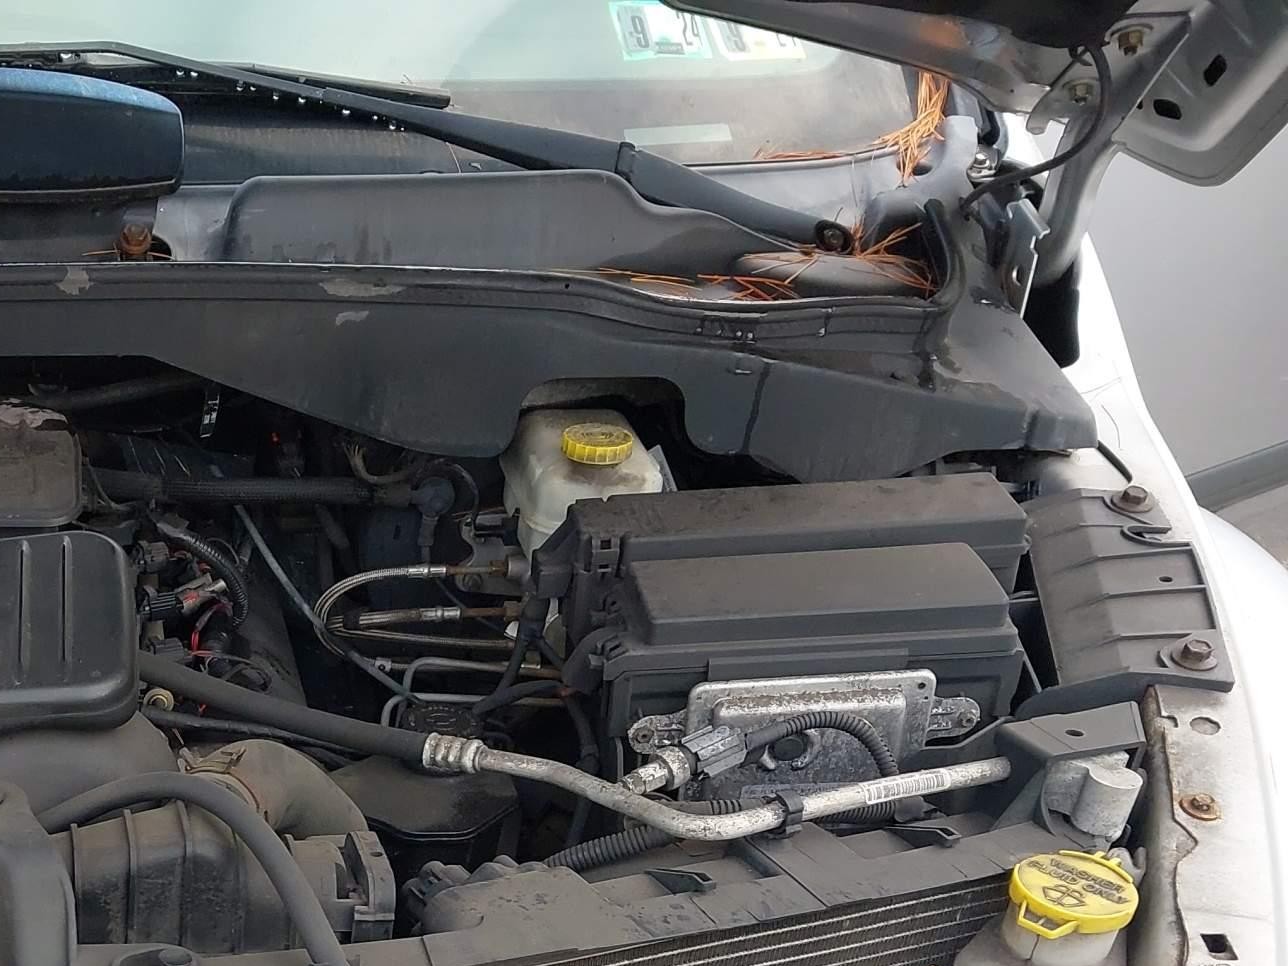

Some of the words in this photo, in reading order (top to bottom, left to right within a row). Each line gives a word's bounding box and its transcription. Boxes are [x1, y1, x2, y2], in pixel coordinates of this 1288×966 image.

[630, 14, 650, 49] 9
[1028, 860, 1080, 886] FLUID
[1082, 883, 1130, 905] ONLY
[1050, 858, 1125, 894] WASHER
